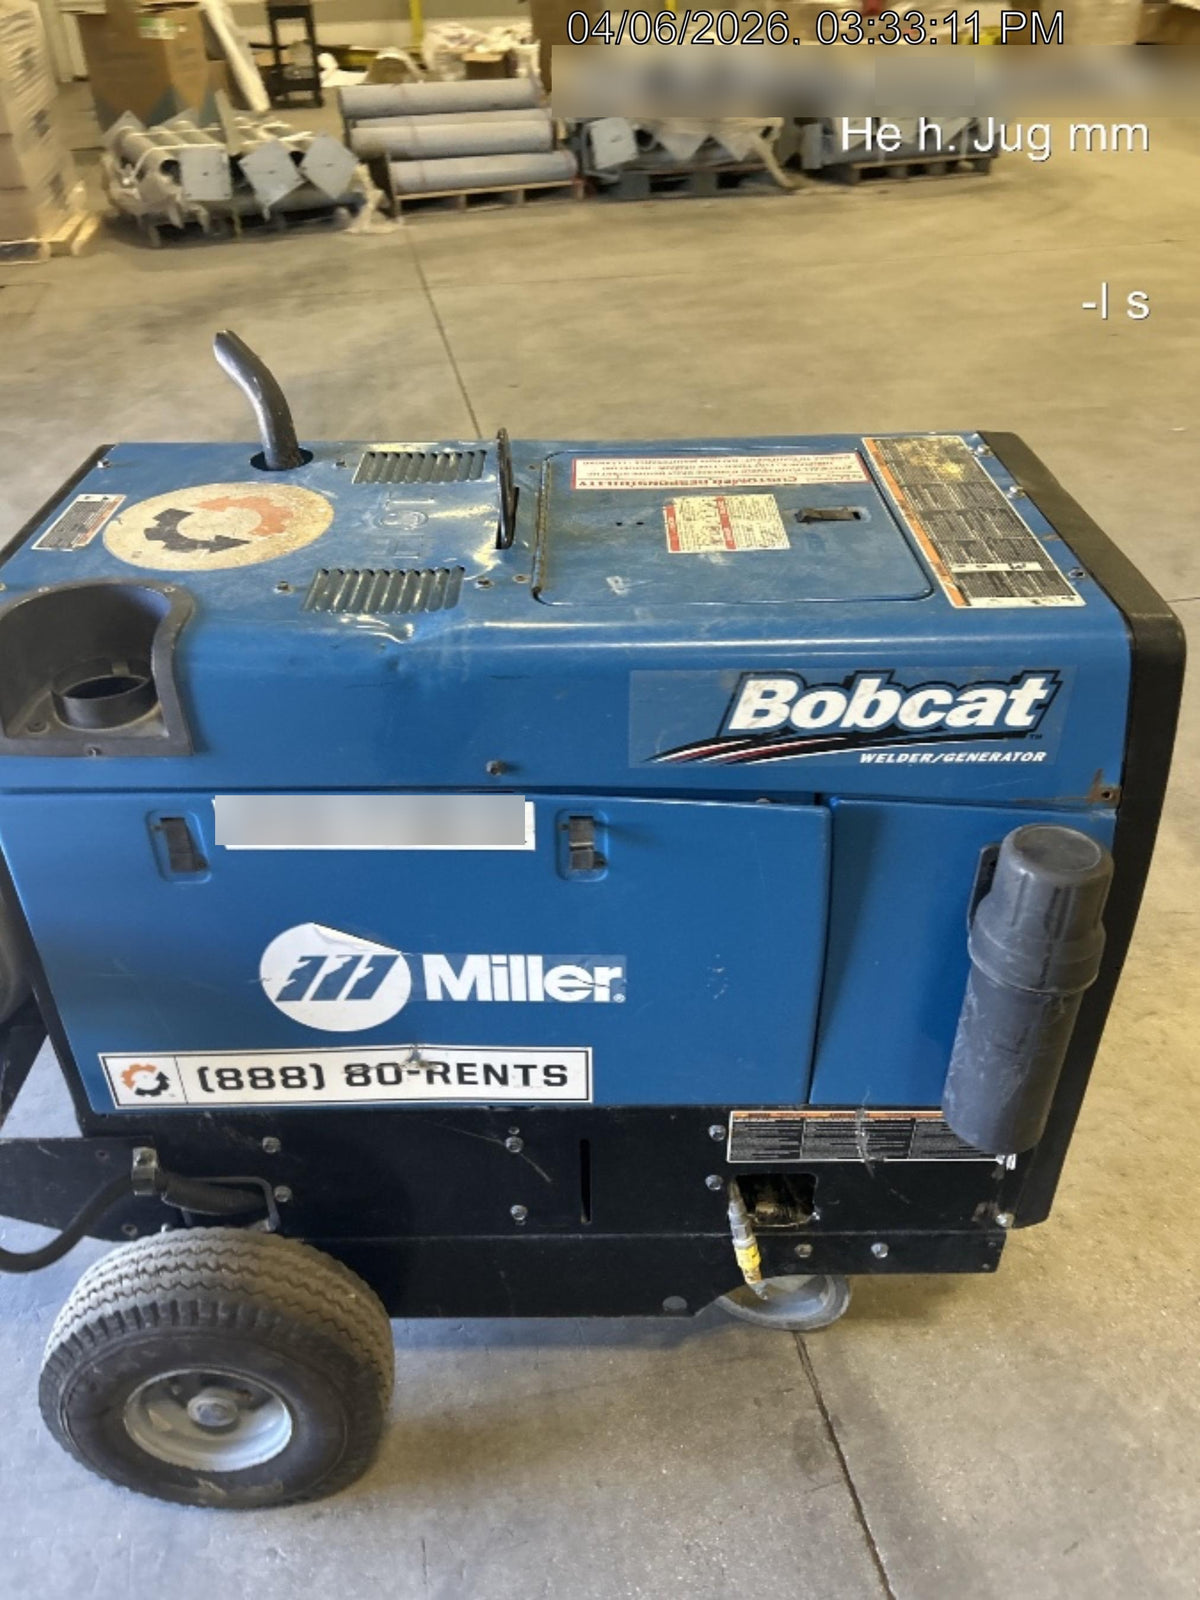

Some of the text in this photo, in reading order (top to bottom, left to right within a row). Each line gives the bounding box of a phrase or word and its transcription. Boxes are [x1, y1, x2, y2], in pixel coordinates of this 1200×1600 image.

[727, 674, 1057, 732] Bobcat
[859, 750, 1048, 765] WELDER/GENERATOR
[423, 954, 624, 1003] Miller
[197, 1060, 569, 1093] (888) 80-RENTS
